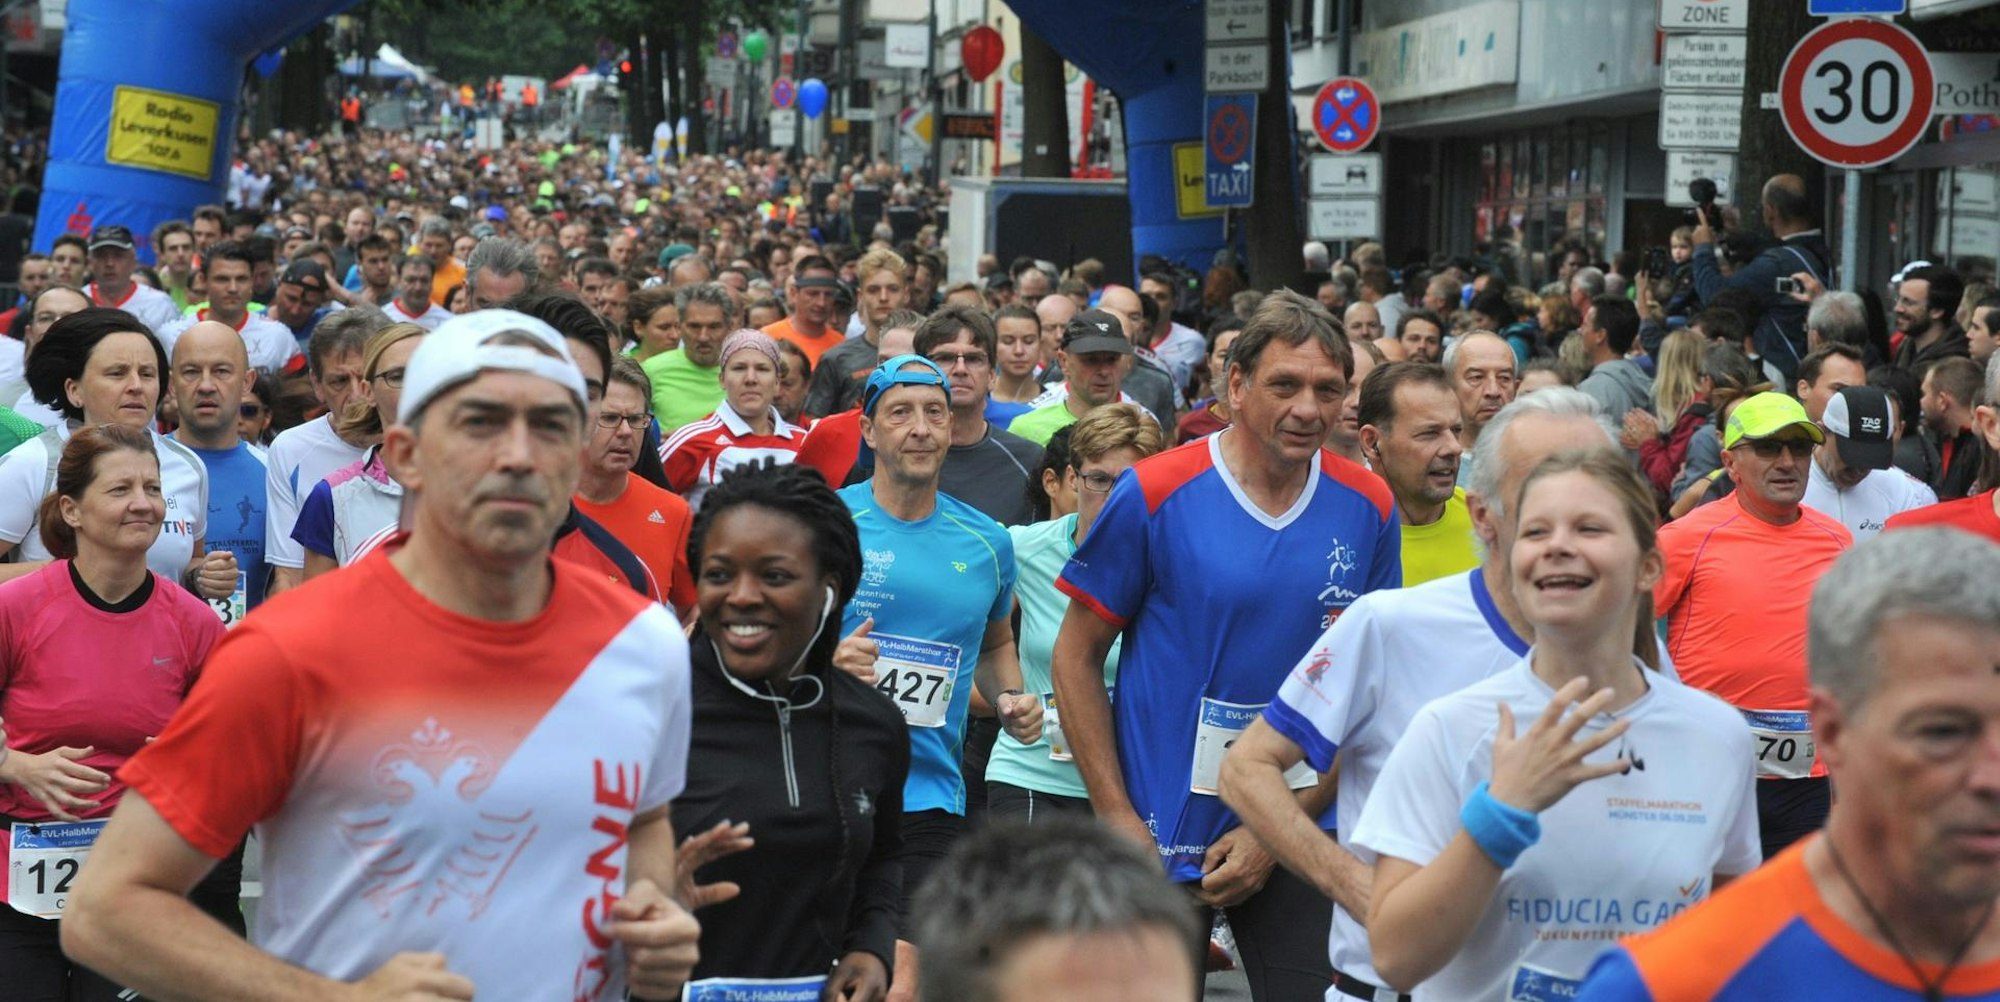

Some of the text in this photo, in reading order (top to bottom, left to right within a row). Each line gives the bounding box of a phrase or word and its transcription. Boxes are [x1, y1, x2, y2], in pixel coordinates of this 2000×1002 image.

[1683, 6, 1730, 23] ZONE
[1814, 60, 1900, 125] 30
[145, 102, 194, 124] Radio
[120, 117, 209, 147] Leverkusen
[1209, 172, 1249, 197] TAXI
[851, 599, 882, 609] Trainer
[1508, 898, 1621, 924] FIDUCIA
